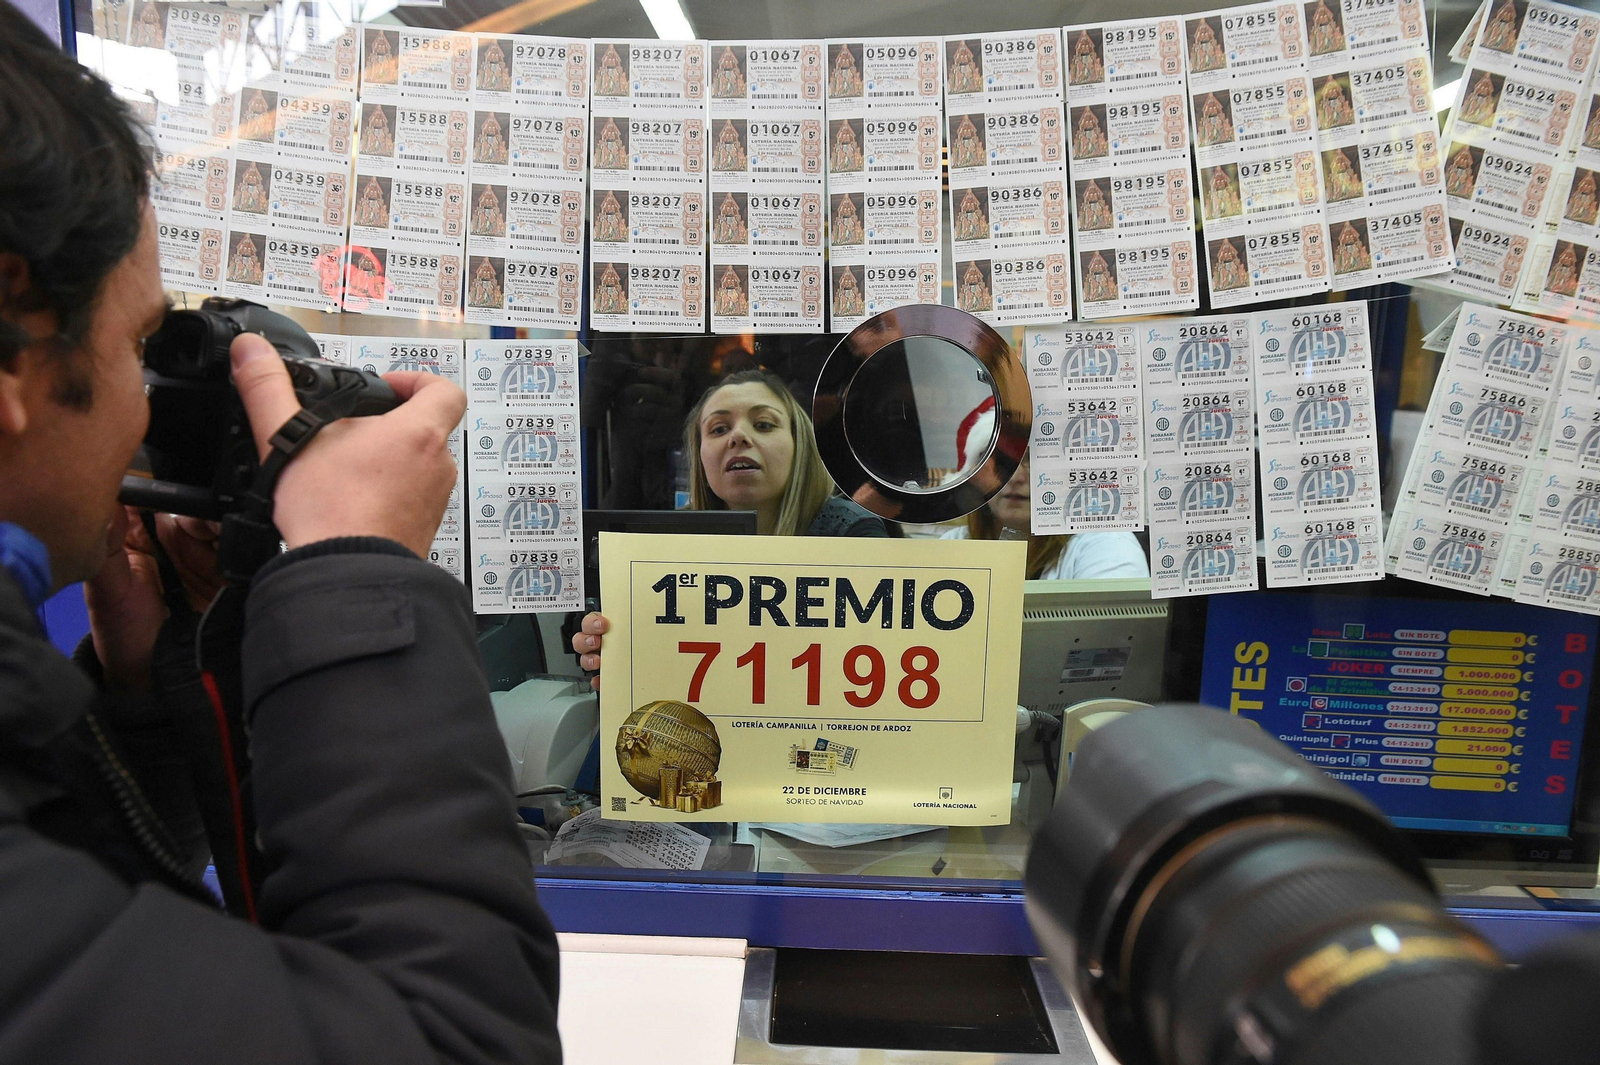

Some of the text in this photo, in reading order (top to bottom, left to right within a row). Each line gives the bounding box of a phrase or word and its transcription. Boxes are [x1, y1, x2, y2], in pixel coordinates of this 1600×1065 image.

[171, 7, 221, 26] 30949
[1224, 12, 1276, 30] 07855
[1528, 7, 1580, 30] 09024
[1104, 27, 1157, 44] 98195
[402, 36, 451, 50] 15588
[985, 41, 1035, 53] 90386
[516, 45, 566, 59] 97078
[632, 48, 682, 60] 98207
[750, 50, 799, 60] 01067
[867, 48, 917, 59] 05096
[1354, 66, 1404, 85] 37405
[1232, 86, 1285, 104] 07855
[1505, 81, 1555, 104] 09024
[280, 97, 331, 115] 04359
[1109, 102, 1161, 119] 98195
[401, 112, 446, 124] 15588
[988, 114, 1038, 129] 90386
[513, 119, 563, 131] 97078
[631, 122, 681, 134] 98207
[750, 123, 800, 134] 01067
[867, 122, 917, 133] 05096
[1362, 140, 1413, 158] 37405
[1241, 159, 1293, 177] 07855
[1484, 154, 1533, 177] 09024
[274, 169, 325, 186] 04359
[1113, 175, 1165, 192] 98195
[396, 184, 442, 196] 15588
[991, 187, 1042, 202] 90386
[511, 192, 560, 205] 97078
[631, 195, 681, 207] 98207
[751, 198, 800, 207] 01067
[867, 196, 917, 208] 05096
[1371, 213, 1421, 231] 37405
[160, 226, 199, 240] 0949
[1463, 226, 1510, 248] 09024
[1249, 232, 1299, 248] 07855
[269, 242, 319, 256] 04359
[1118, 247, 1169, 263] 98195
[391, 255, 437, 267] 15588
[994, 260, 1045, 274] 90386
[508, 264, 557, 277] 97078
[631, 267, 681, 280] 98207
[751, 269, 801, 281] 01067
[867, 268, 917, 280] 05096
[1292, 313, 1341, 326] 60168
[1180, 325, 1228, 337] 20864
[1499, 320, 1544, 338] 75846
[1066, 332, 1113, 342] 53642
[391, 347, 438, 357] 25680
[505, 349, 552, 358] 07839
[1297, 383, 1346, 396] 60168
[1183, 395, 1230, 407] 20864
[1481, 389, 1525, 407] 75846
[1069, 401, 1116, 412] 53642
[506, 418, 554, 427] 07839
[1301, 453, 1350, 466] 60168
[1461, 456, 1506, 475] 75846
[1070, 471, 1117, 481] 53642
[1185, 465, 1231, 477] 20864
[508, 486, 555, 495] 07839
[1305, 521, 1354, 534] 60168
[1442, 524, 1486, 542] 75846
[1187, 532, 1232, 545] 20864
[510, 553, 557, 563] 07839
[651, 573, 976, 631] 1er PREMIO
[1418, 632, 1440, 640] BOTE
[1514, 636, 1521, 644] 0
[1512, 654, 1519, 662] 0
[1328, 661, 1385, 674] JOKER
[1397, 667, 1435, 675] SIEMPRE
[678, 641, 941, 709] 71198
[1230, 640, 1270, 722] TES
[1458, 671, 1516, 680] 1.000.000
[1456, 688, 1514, 697] 5.000.000
[1279, 698, 1384, 711] Euro Millones
[1390, 704, 1434, 712] 22-12-2017
[1446, 706, 1511, 716] 17.000.000
[732, 720, 764, 729] LOTERÍA
[766, 722, 817, 730] CAMPANILLA
[826, 724, 868, 732] TORREJON
[871, 724, 881, 732] DE
[1324, 717, 1372, 726] Lototurf
[1388, 722, 1431, 730] 24-12-2017
[1451, 725, 1509, 735] 1.852.000
[1279, 734, 1379, 746] Quintuple Plus
[1467, 744, 1506, 753] 21.000
[782, 786, 866, 796] 22 DE DICIEMBRE
